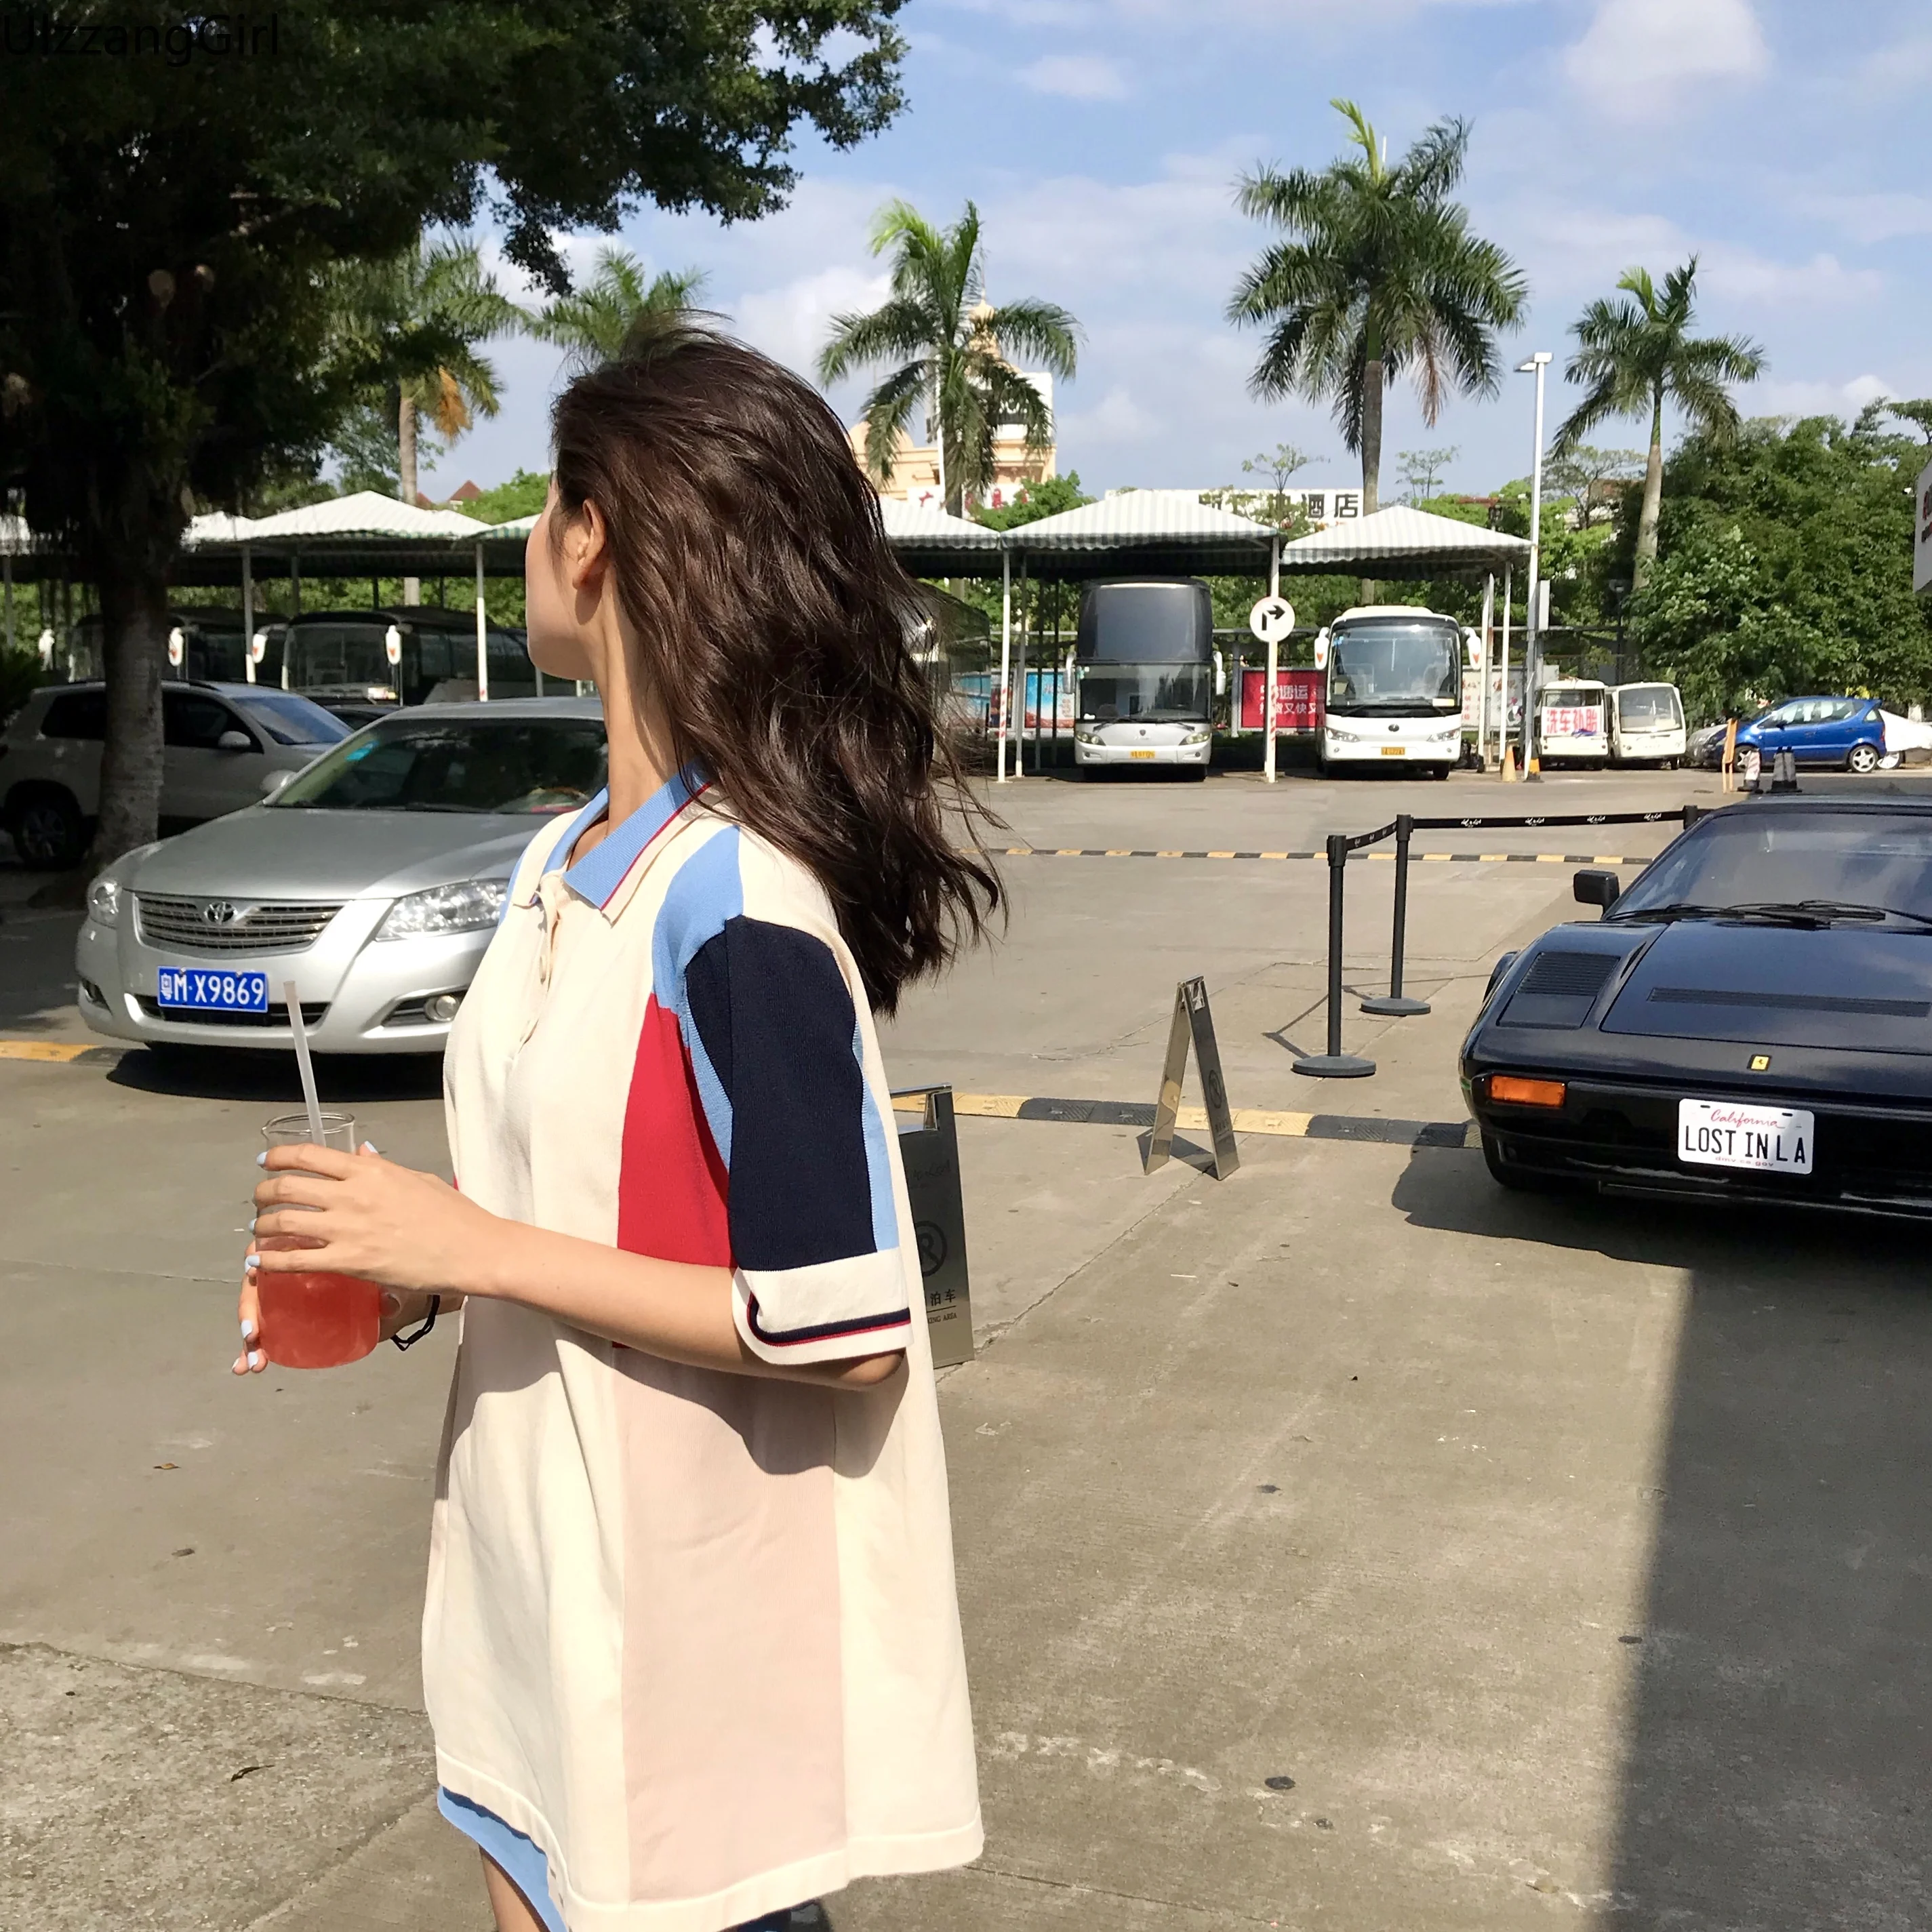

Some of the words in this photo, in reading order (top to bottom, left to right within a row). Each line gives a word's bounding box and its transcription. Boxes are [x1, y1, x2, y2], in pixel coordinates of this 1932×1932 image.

[1710, 1108, 1786, 1129] California
[1685, 1125, 1737, 1156] LOST
[1745, 1131, 1769, 1159] IN
[942, 1312, 958, 1321] AREA
